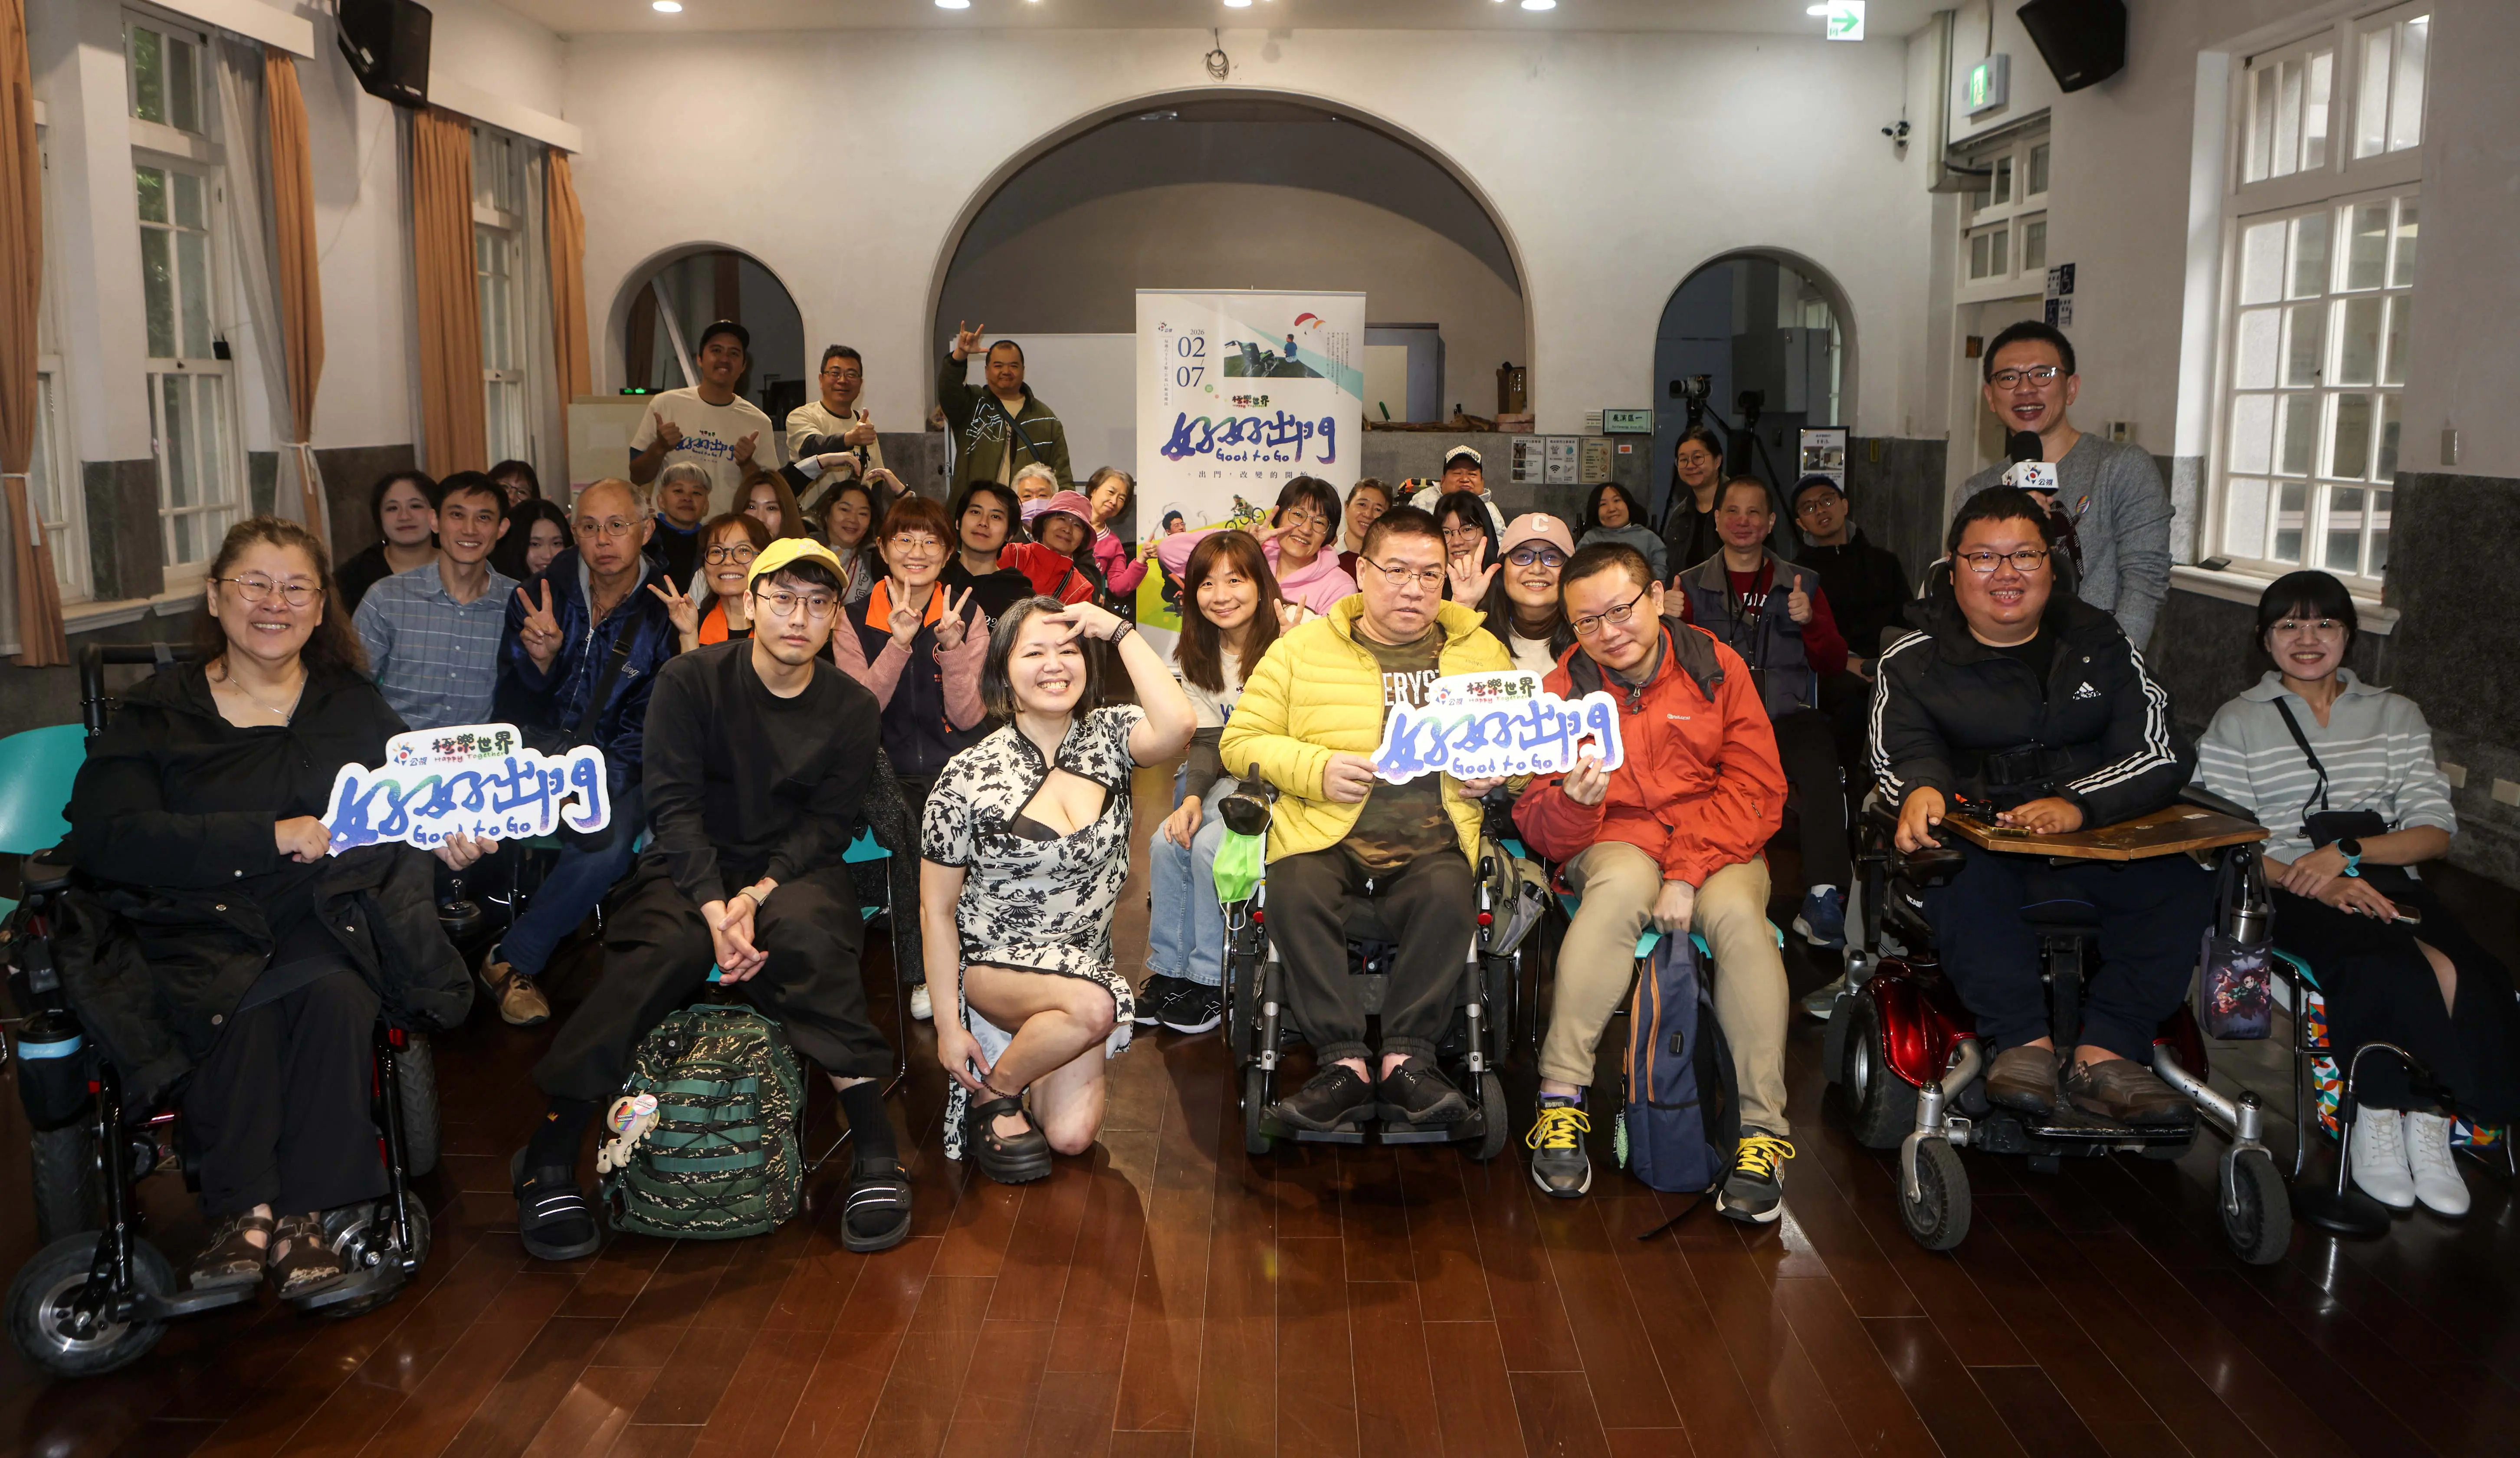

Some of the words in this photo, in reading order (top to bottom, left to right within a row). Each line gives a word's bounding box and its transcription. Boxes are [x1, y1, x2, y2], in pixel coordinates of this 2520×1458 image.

[1178, 337, 1206, 357] 02
[1177, 366, 1205, 387] 07
[1161, 410, 1335, 464] 好好出門
[1216, 448, 1247, 462] Good
[1253, 449, 1270, 462] to
[1274, 450, 1289, 462] Go
[1532, 515, 1549, 532] C
[1382, 668, 1439, 706] ERYS
[1467, 677, 1536, 698] 極樂世界
[410, 757, 427, 766] 公視
[432, 731, 513, 755] 極樂世界
[1377, 699, 1615, 780] 好好出門
[467, 751, 505, 759] Together
[1453, 757, 1496, 775] Good
[1503, 755, 1526, 771] to
[1532, 753, 1553, 769] Go
[330, 756, 601, 853] 好好出門
[473, 819, 500, 837] to
[506, 816, 531, 834] Go
